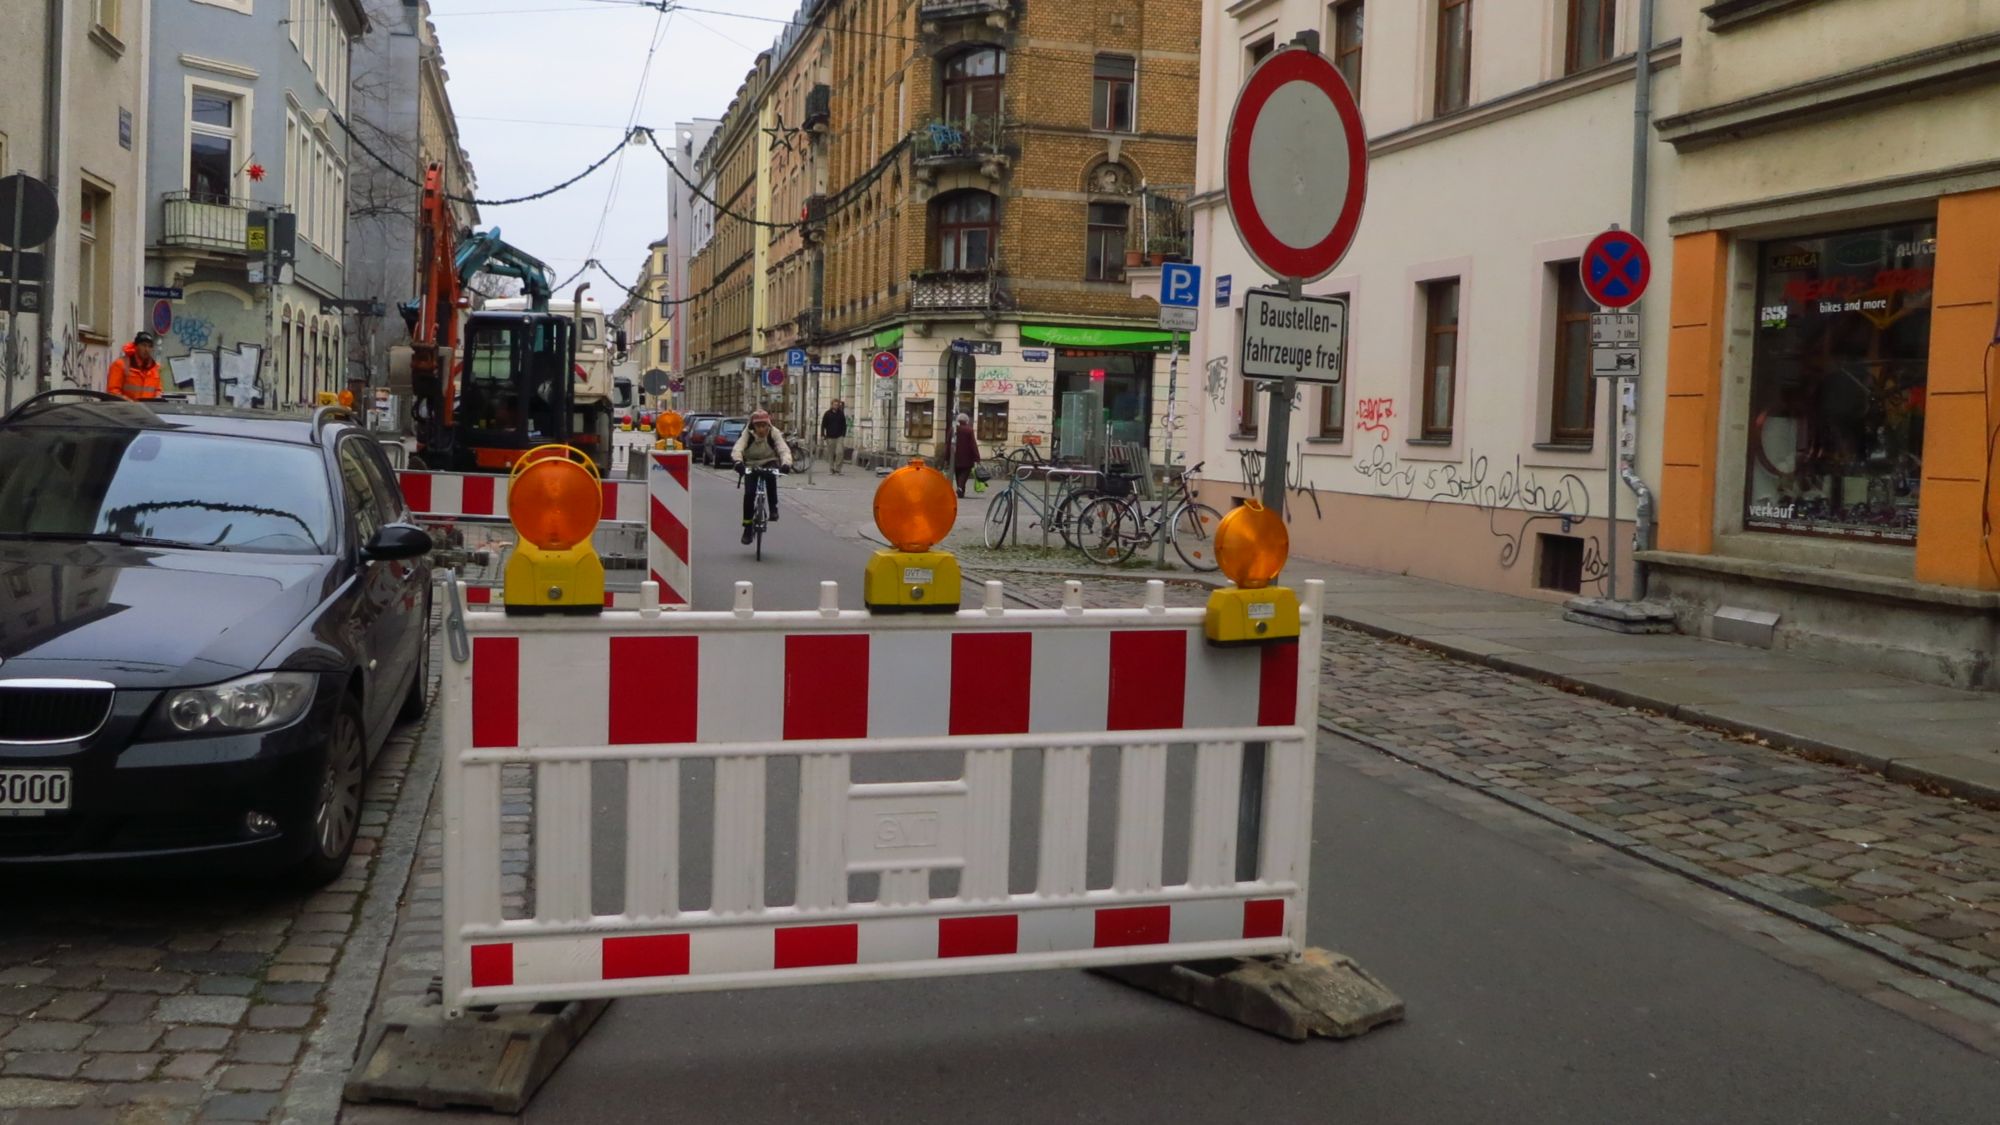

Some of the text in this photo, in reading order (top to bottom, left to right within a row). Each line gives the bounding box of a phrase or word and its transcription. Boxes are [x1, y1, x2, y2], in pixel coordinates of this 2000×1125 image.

[1169, 269, 1191, 300] P
[1260, 301, 1337, 333] Baustellen-
[1820, 300, 1886, 313] bikes and more
[1246, 336, 1340, 372] fahrzeuge frei
[1749, 503, 1795, 518] verkauf
